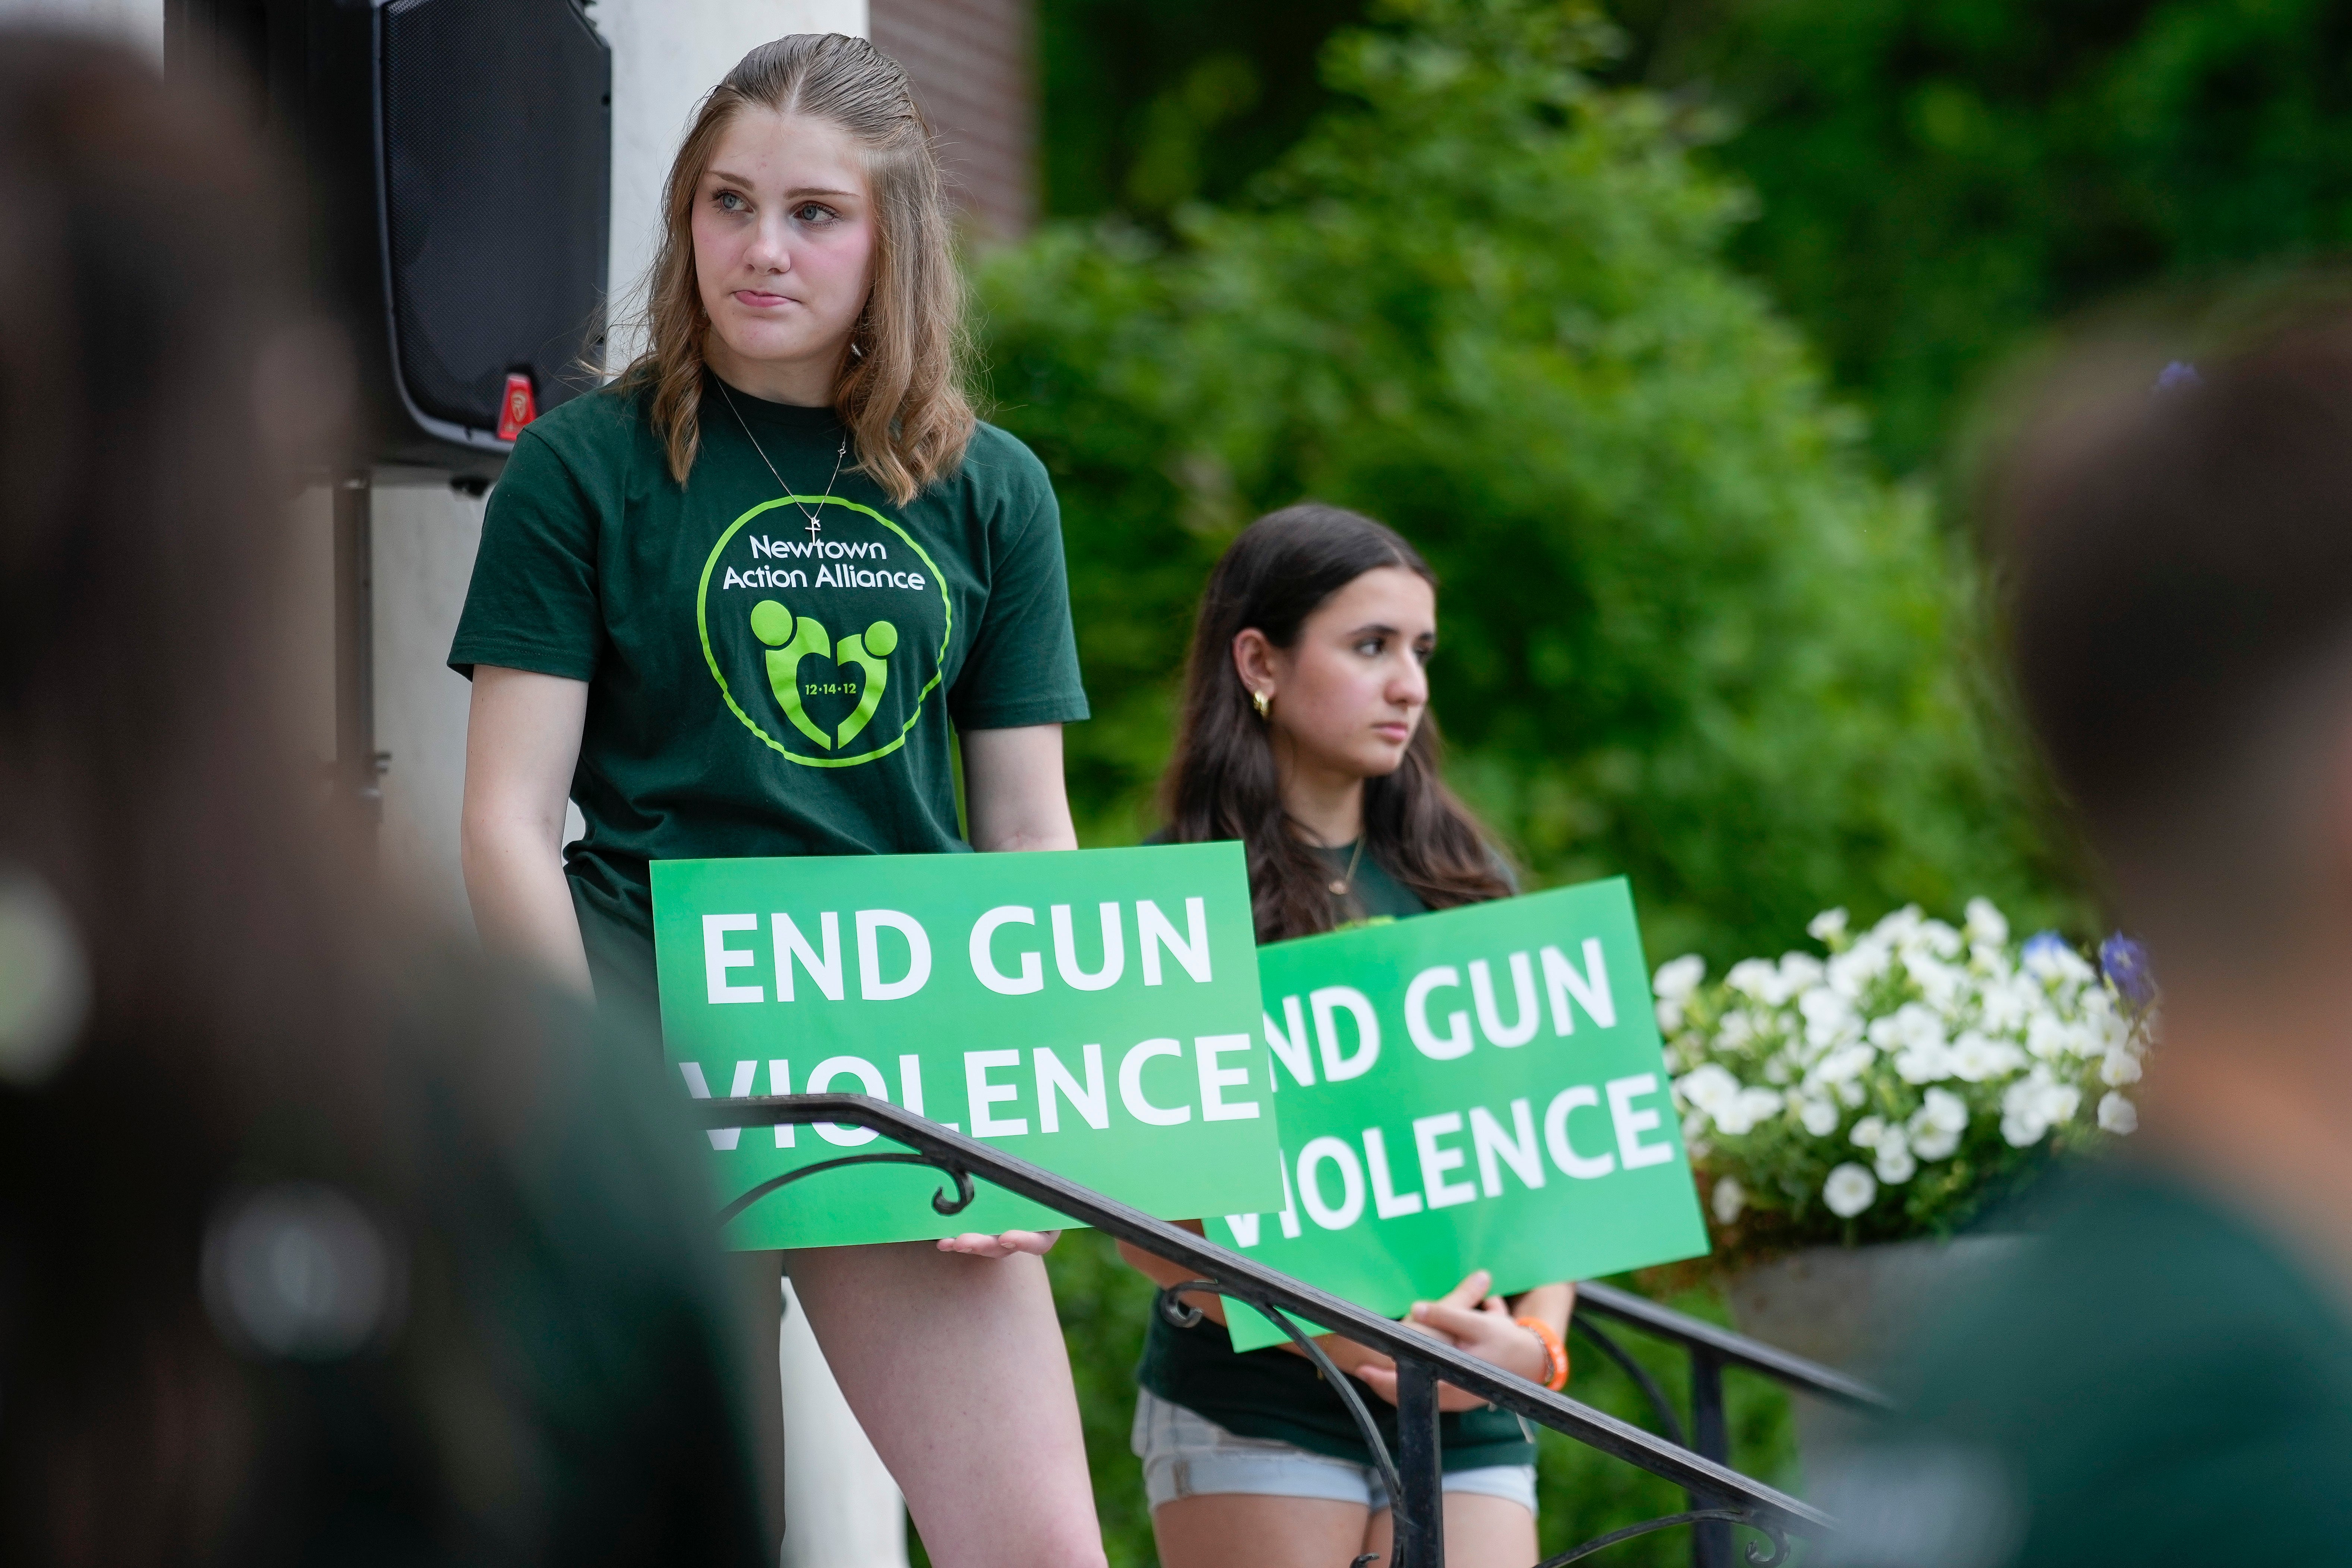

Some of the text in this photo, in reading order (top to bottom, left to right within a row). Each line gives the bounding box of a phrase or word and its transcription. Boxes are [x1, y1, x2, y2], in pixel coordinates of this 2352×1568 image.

[723, 563, 926, 590] Action Alliance
[749, 535, 887, 559] Newtown
[702, 897, 1213, 1004] END GUN
[1262, 938, 1617, 1093] ND GUN
